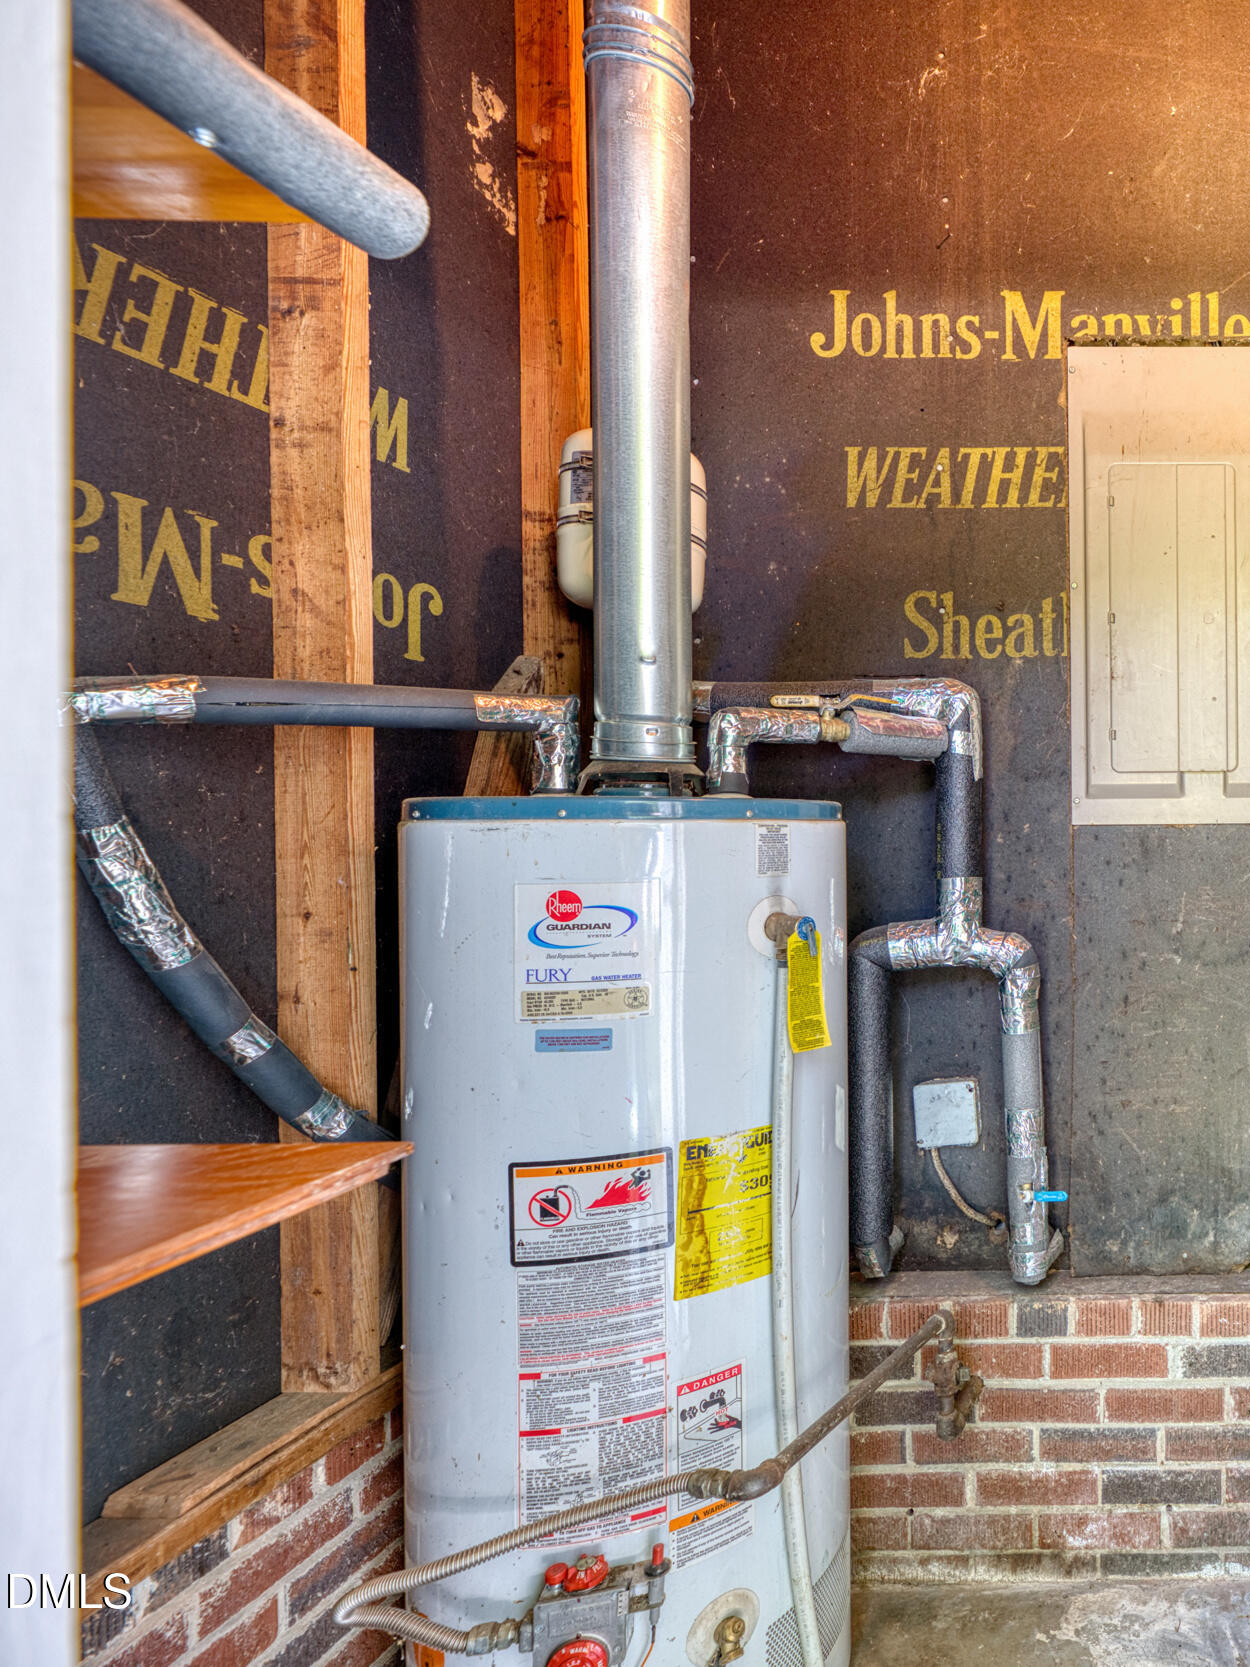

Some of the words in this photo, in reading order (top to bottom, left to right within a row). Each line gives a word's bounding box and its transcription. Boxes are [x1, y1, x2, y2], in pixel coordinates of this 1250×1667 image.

[844, 446, 1068, 509] WEATHE
[903, 590, 1068, 660] Sheat
[548, 890, 581, 917] Rheem
[546, 922, 612, 932] GUARDIAN
[525, 968, 573, 983] FURY
[568, 1161, 624, 1173] WARNING
[740, 1173, 772, 1193] $30
[693, 1367, 738, 1390] DANGER
